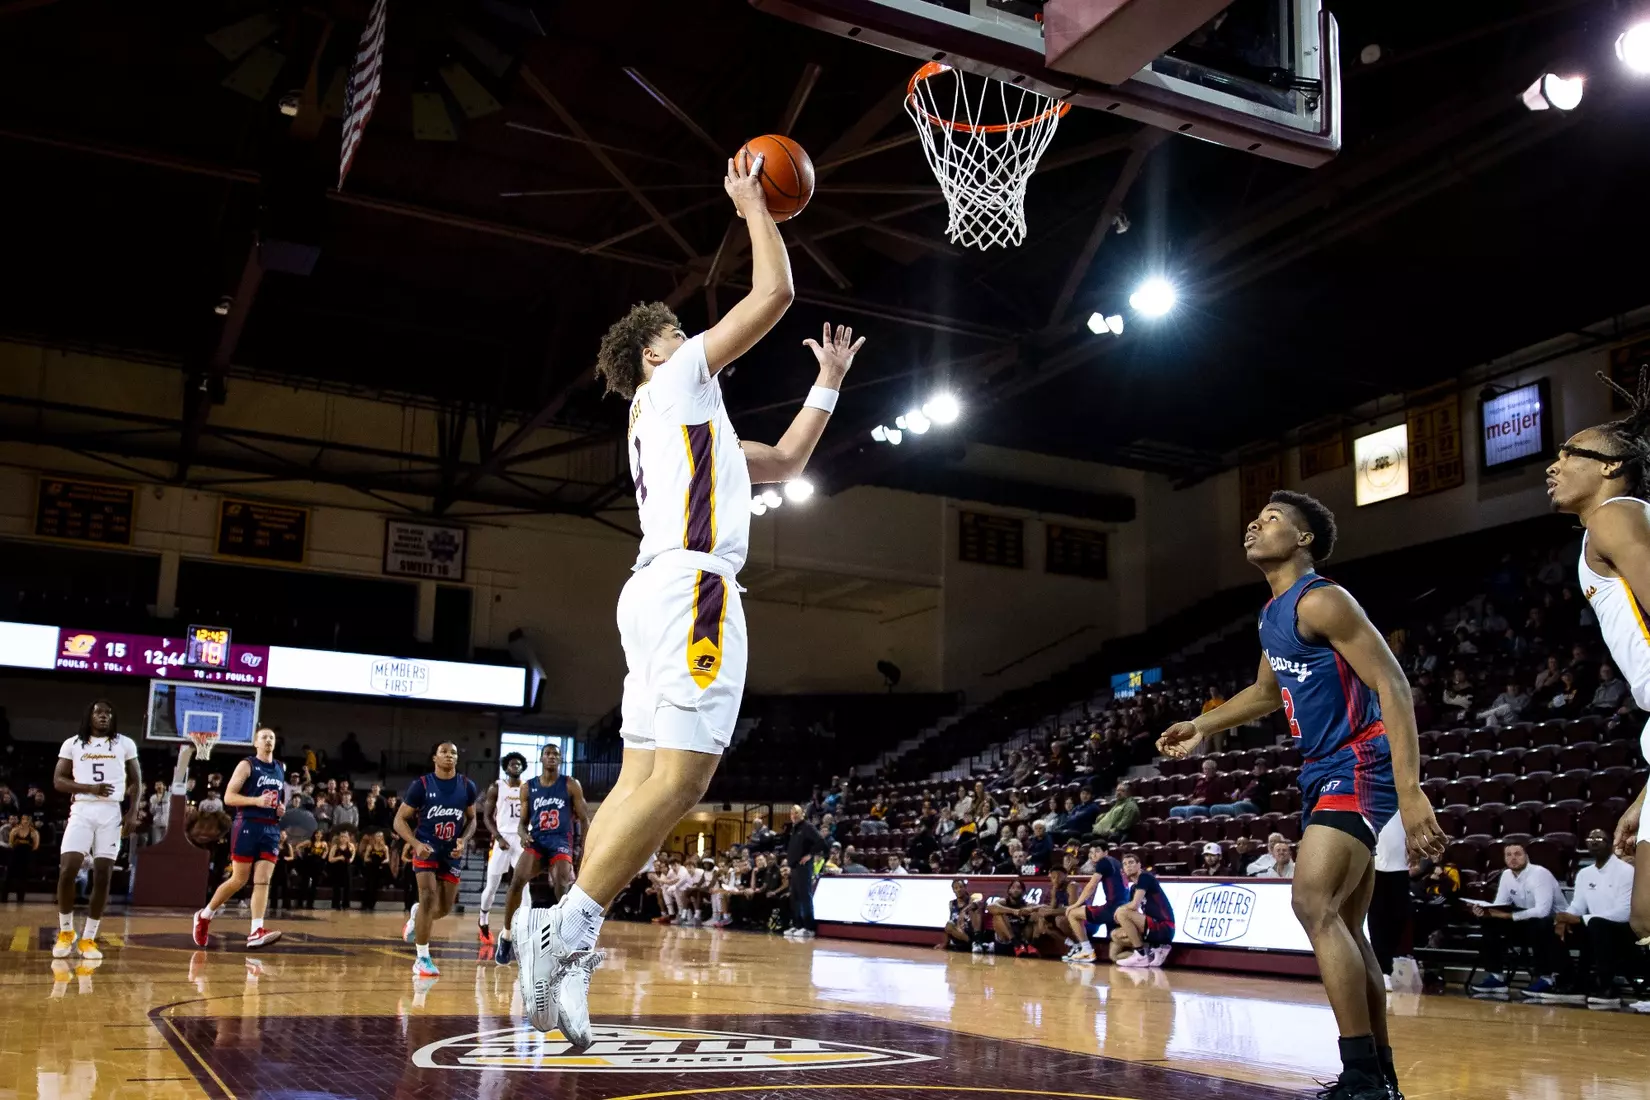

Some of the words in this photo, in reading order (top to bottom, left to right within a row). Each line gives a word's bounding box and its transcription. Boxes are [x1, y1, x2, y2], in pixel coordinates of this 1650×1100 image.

[1486, 412, 1540, 440] meijer
[105, 642, 127, 658] 15
[57, 659, 89, 670] FOULS:
[375, 662, 426, 680] MEMBERS
[385, 679, 414, 692] FIRST
[92, 763, 105, 782] 5
[256, 775, 284, 791] Cleary
[533, 796, 566, 810] Cleary
[427, 804, 464, 821] Cleary
[539, 809, 560, 831] 23
[434, 821, 456, 841] 10
[1191, 890, 1252, 915] MEMBERS
[1197, 917, 1234, 938] FIRST
